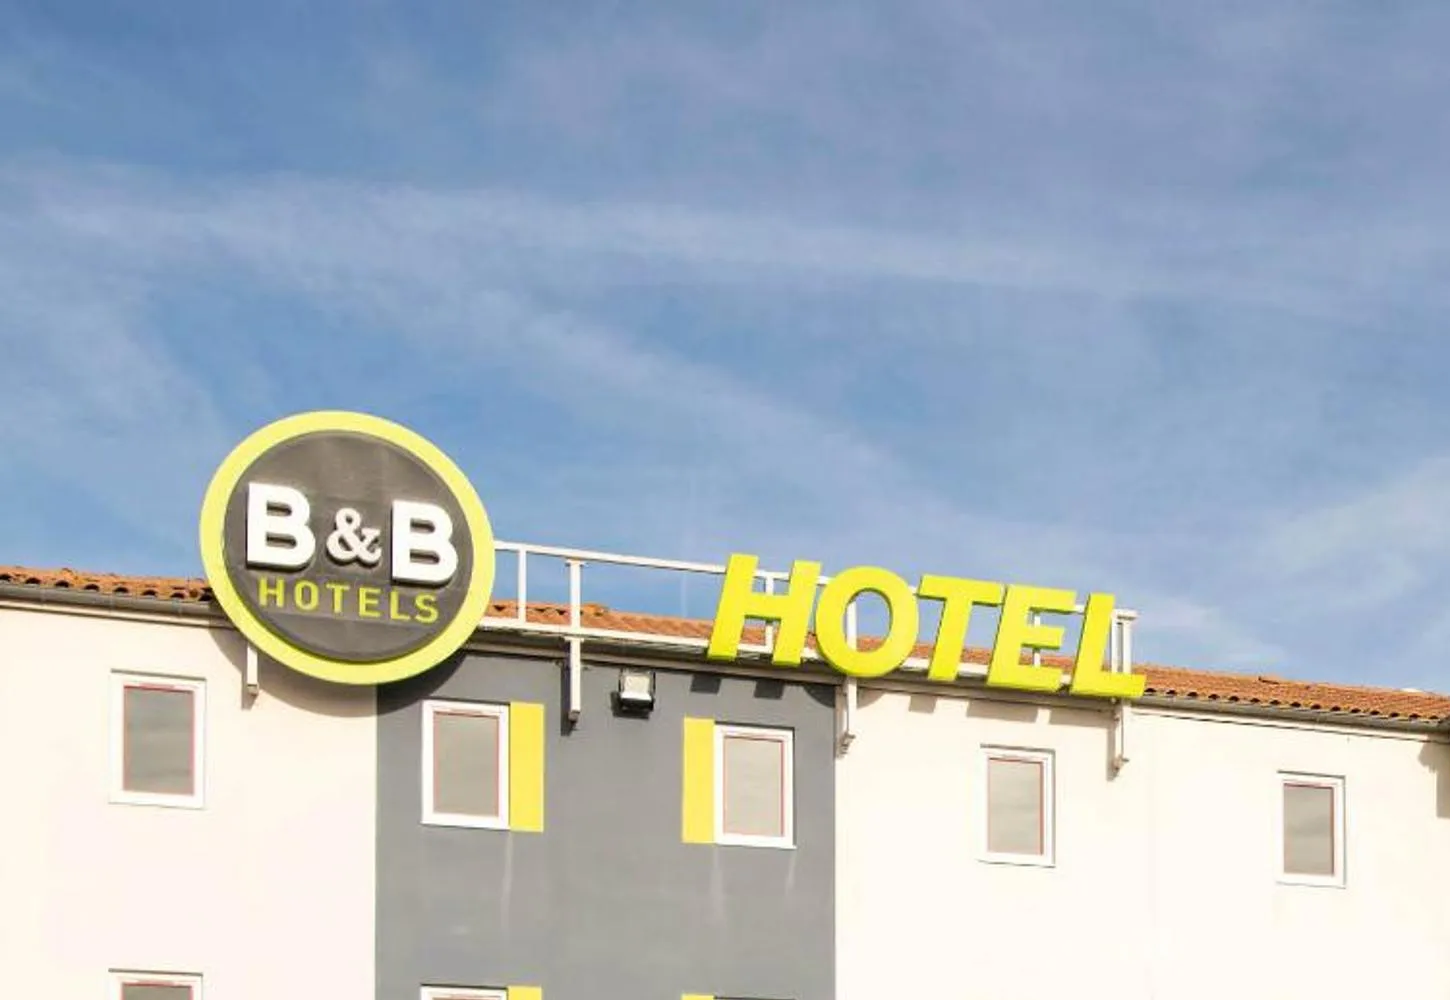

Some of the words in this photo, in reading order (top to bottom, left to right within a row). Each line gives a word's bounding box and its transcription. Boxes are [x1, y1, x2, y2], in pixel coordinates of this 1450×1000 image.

[247, 482, 459, 584] B&B
[258, 575, 440, 624] HOTELS
[707, 553, 1147, 698] HOTEL
